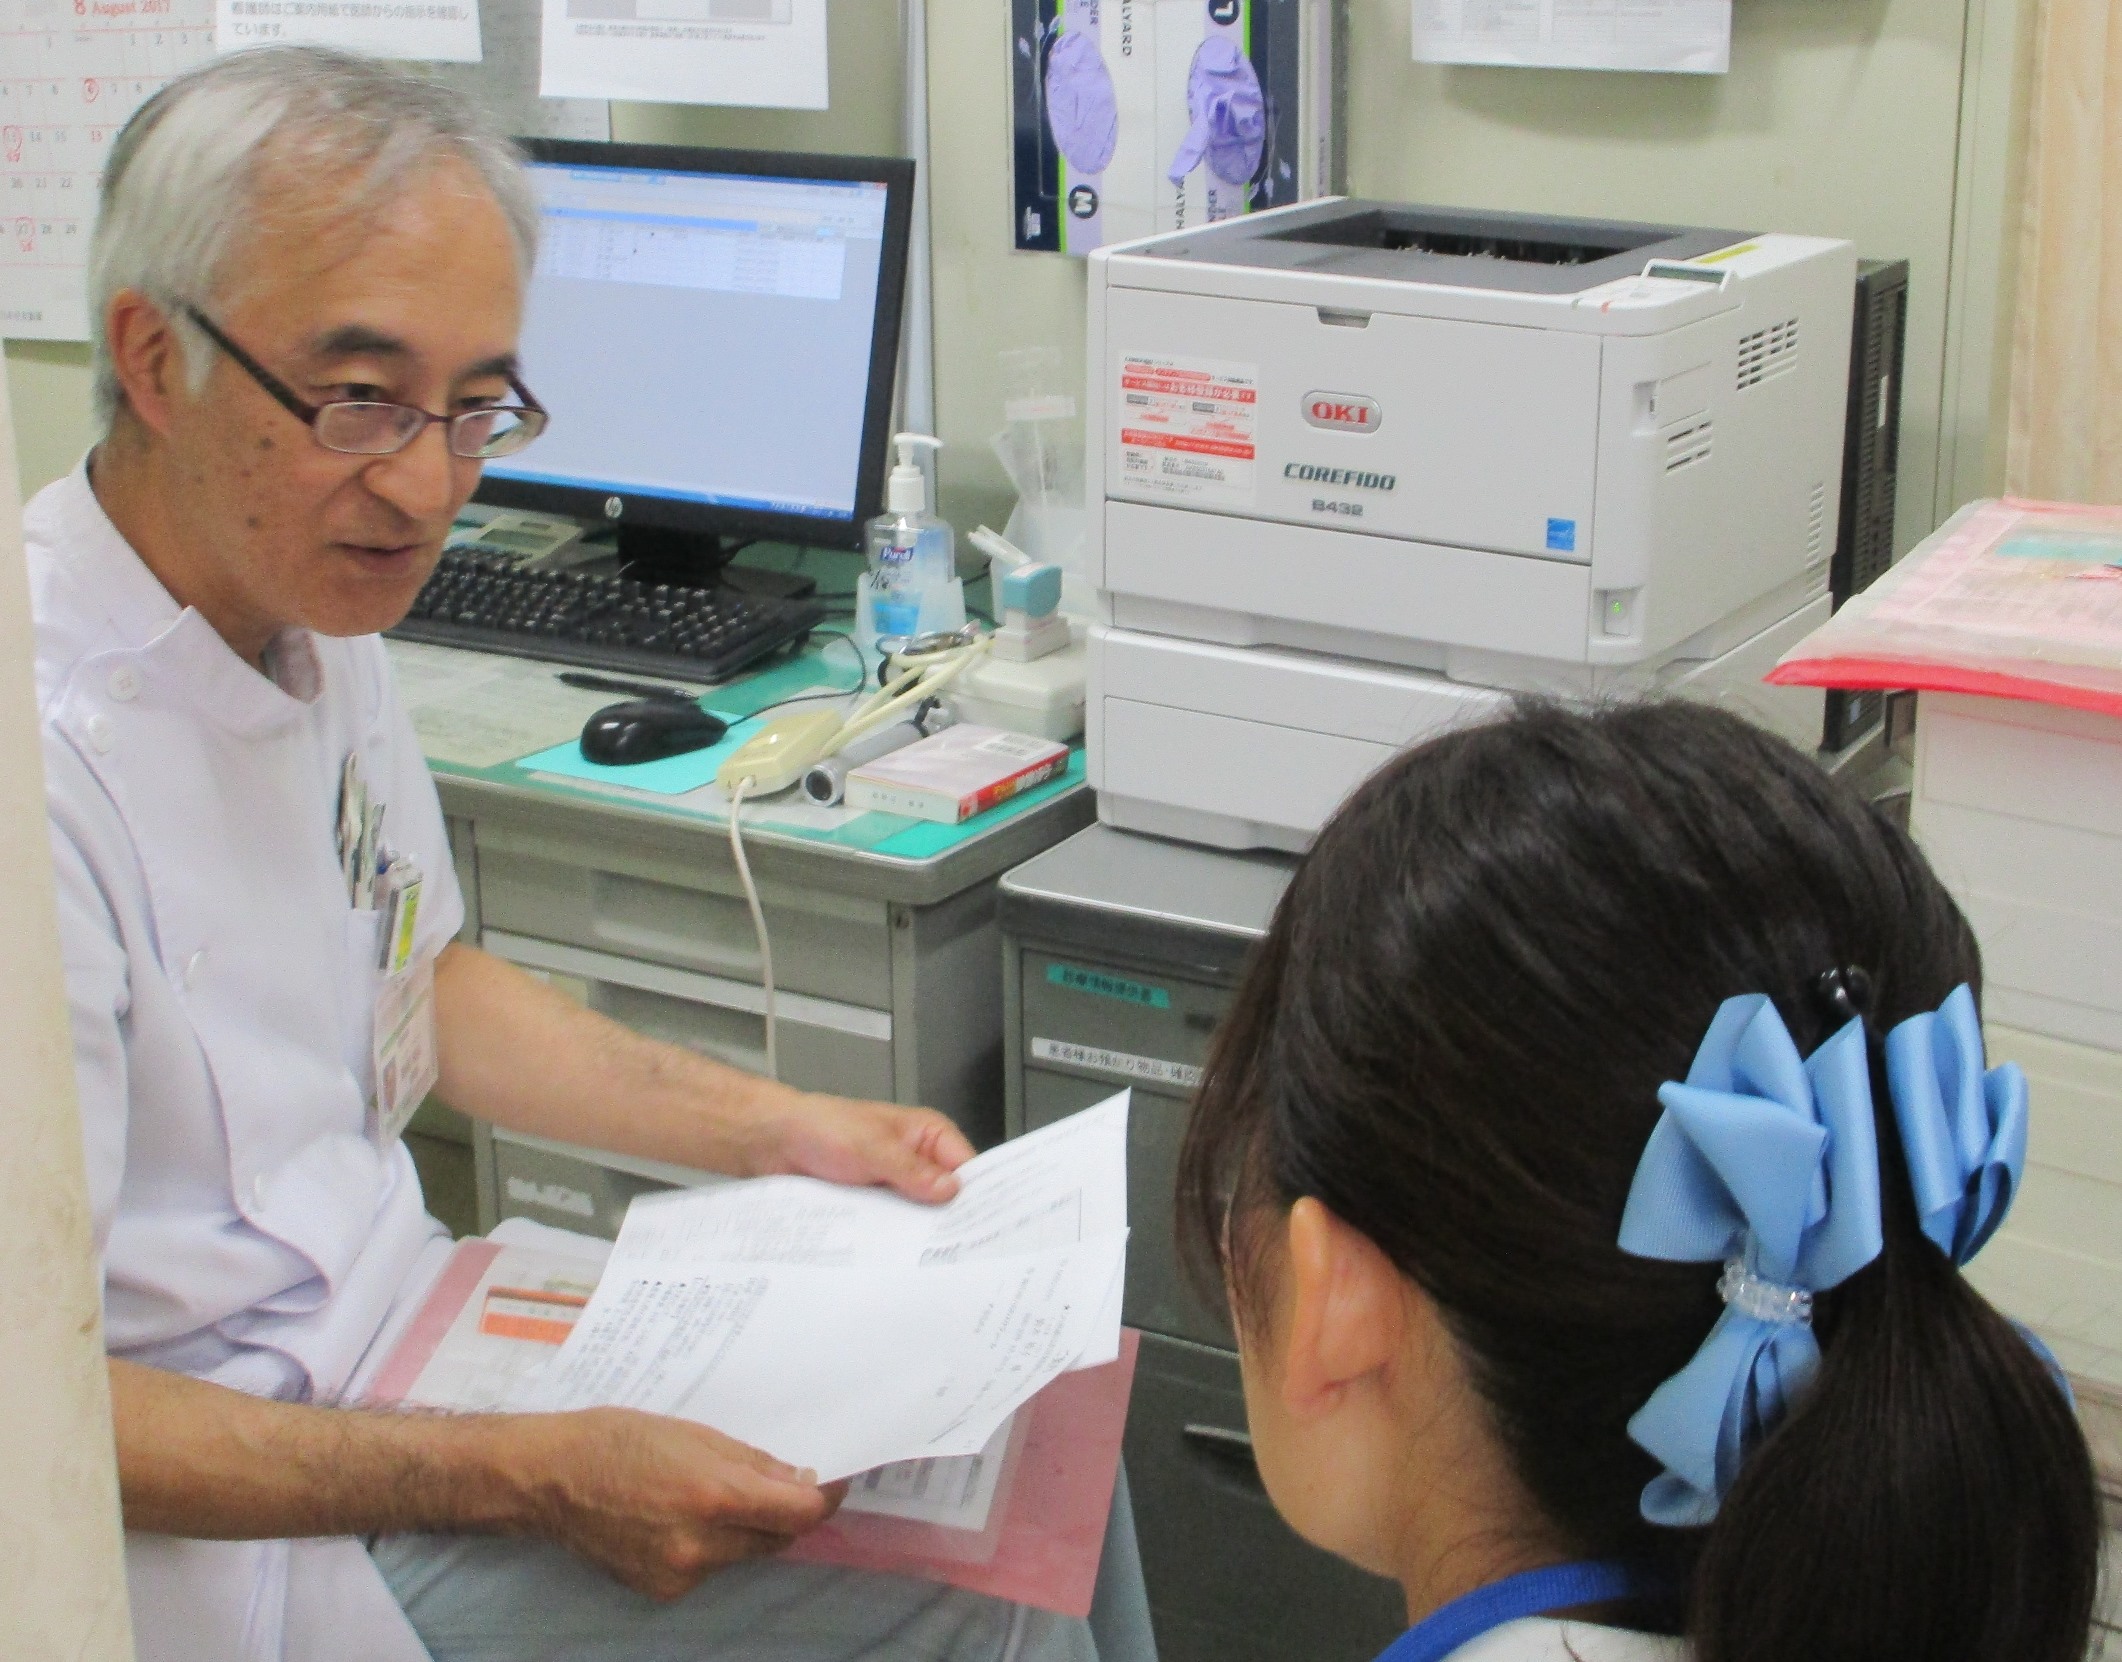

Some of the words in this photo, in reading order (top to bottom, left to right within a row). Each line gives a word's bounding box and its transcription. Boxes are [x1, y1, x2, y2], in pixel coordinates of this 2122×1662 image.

[93, 2, 135, 16] August
[1074, 191, 1093, 213] M
[1176, 176, 1186, 230] HALYA
[1312, 401, 1369, 424] OKI
[1284, 462, 1396, 491] COREFIDO
[1312, 498, 1363, 516] B432
